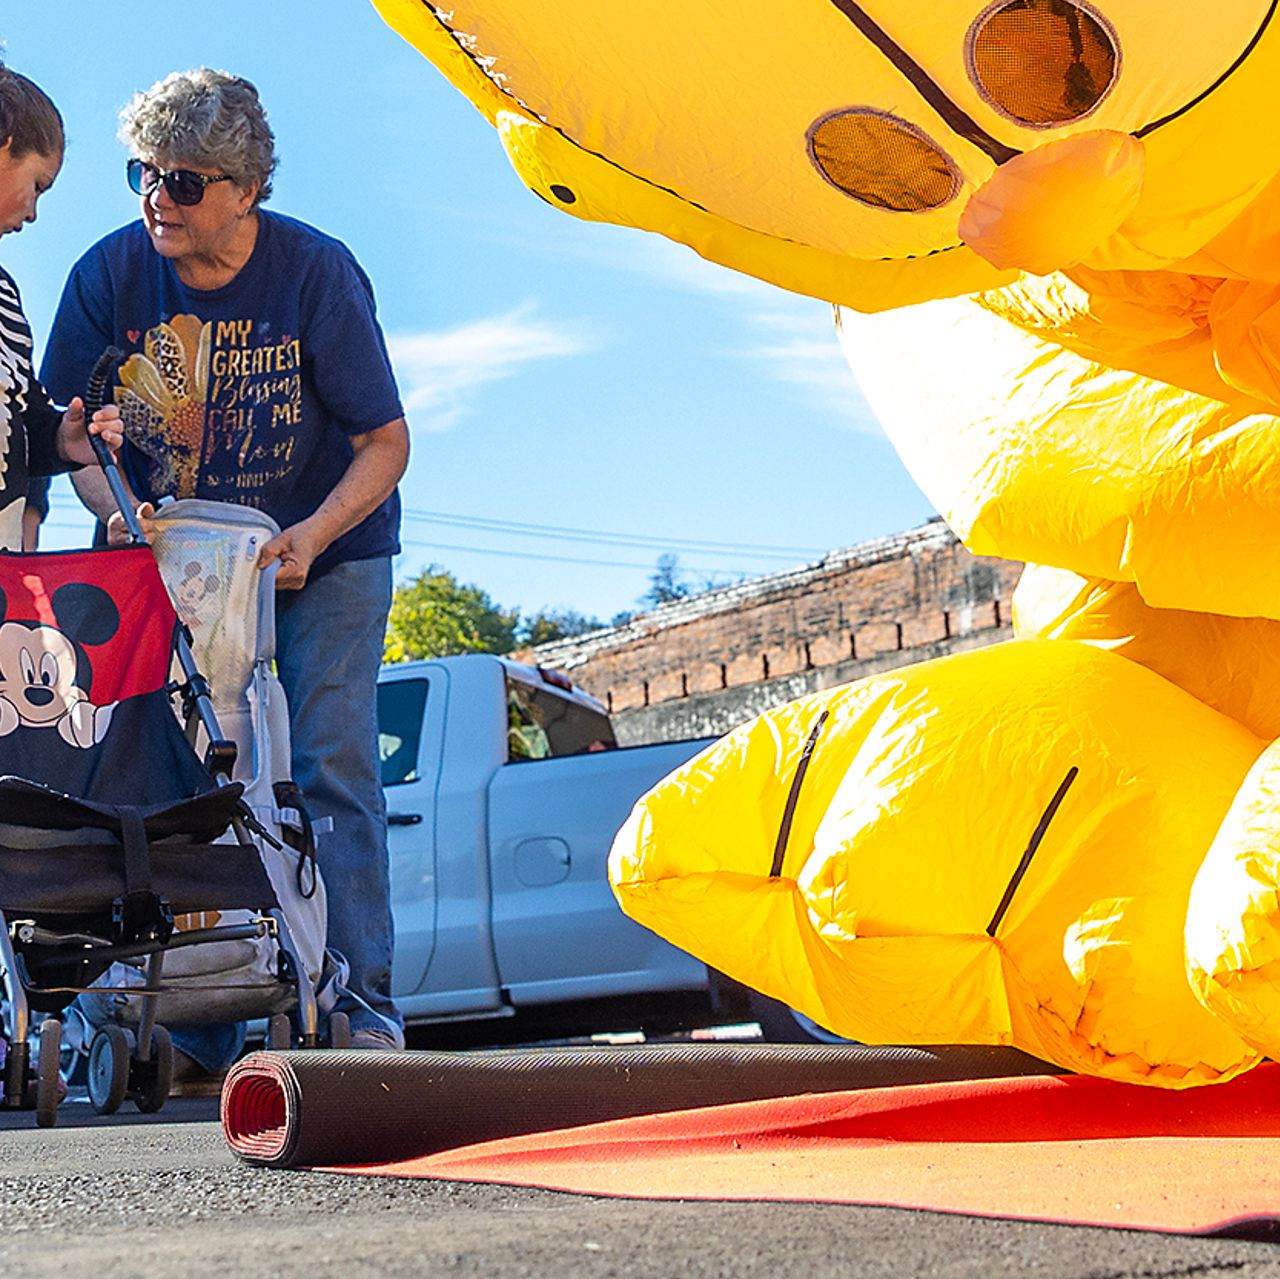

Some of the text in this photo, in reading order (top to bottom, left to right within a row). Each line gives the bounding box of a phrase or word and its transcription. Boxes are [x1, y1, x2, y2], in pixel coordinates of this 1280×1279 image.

[215, 319, 252, 347] MY
[212, 339, 301, 377] GREATEST
[208, 402, 302, 432] CALL ME
